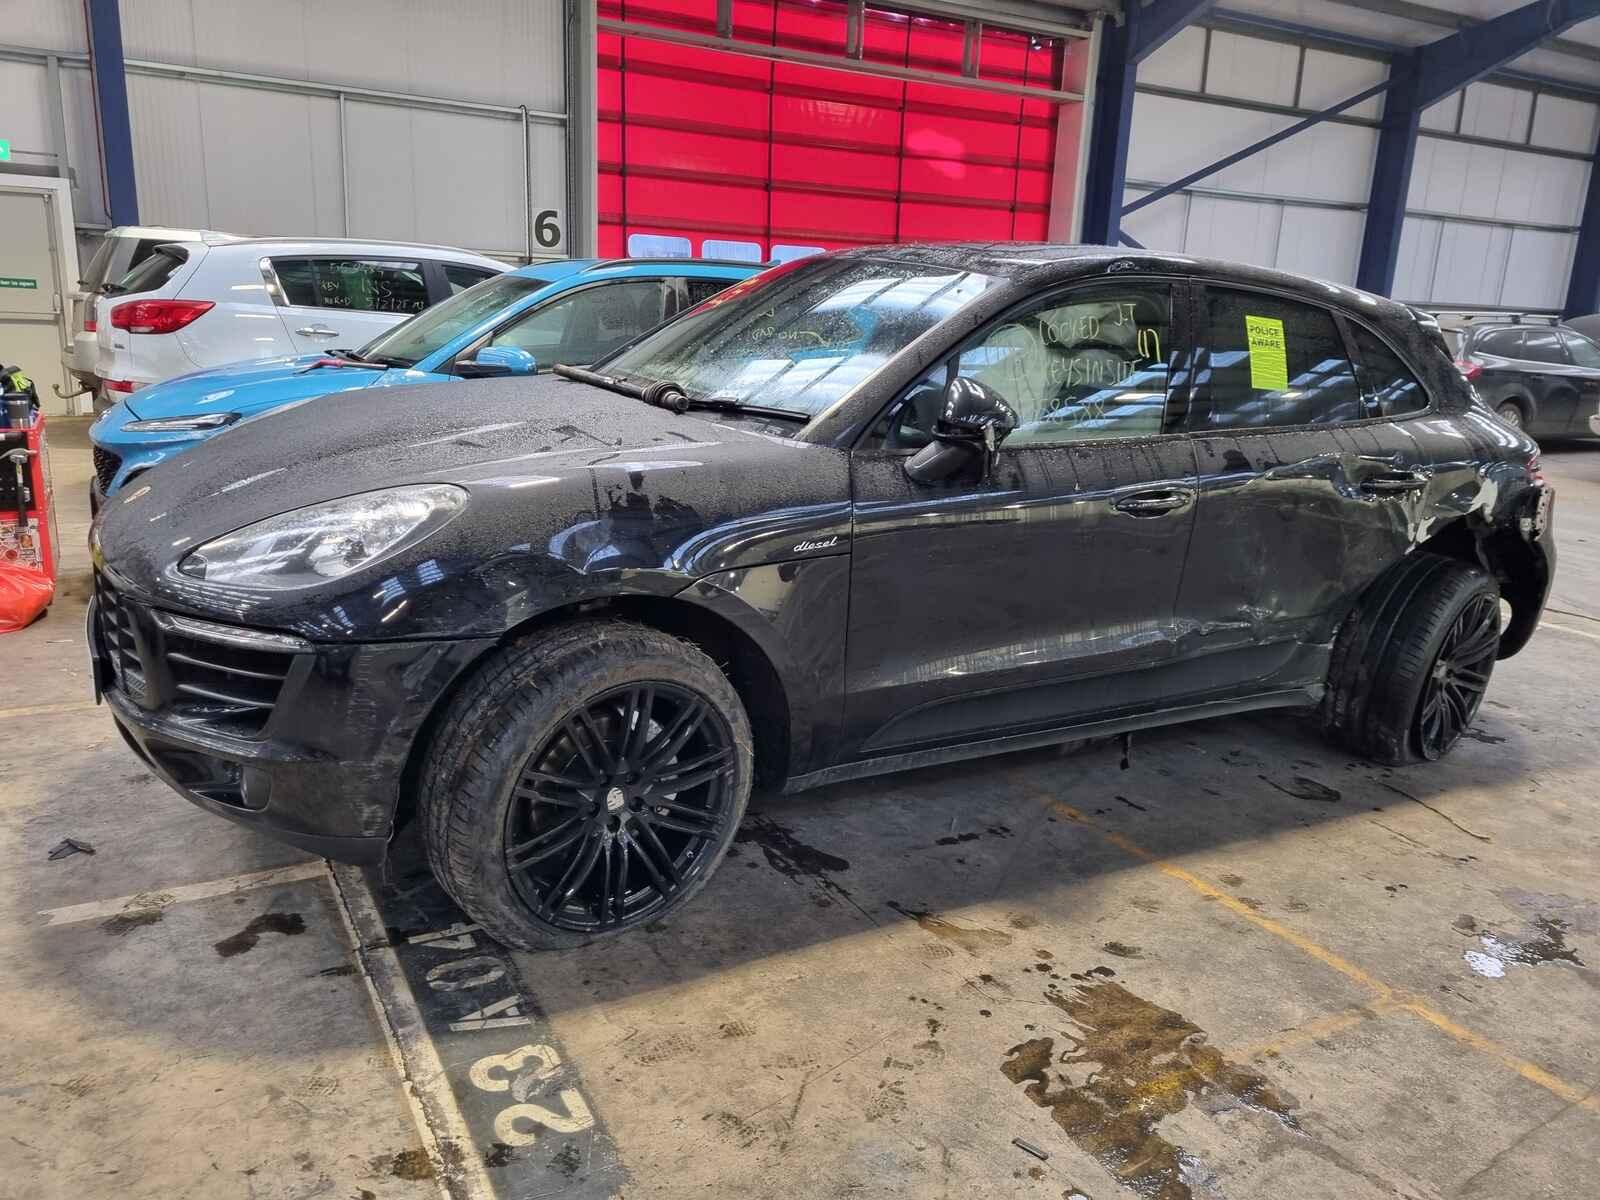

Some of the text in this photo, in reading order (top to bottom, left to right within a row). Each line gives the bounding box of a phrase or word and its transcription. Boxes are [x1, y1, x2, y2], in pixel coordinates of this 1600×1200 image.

[534, 210, 561, 248] 6
[1039, 315, 1100, 346] LOCKED
[1249, 325, 1280, 337] POLICE
[1251, 336, 1281, 348] AWARE
[793, 536, 838, 552] diesel
[469, 1044, 595, 1147] 23
